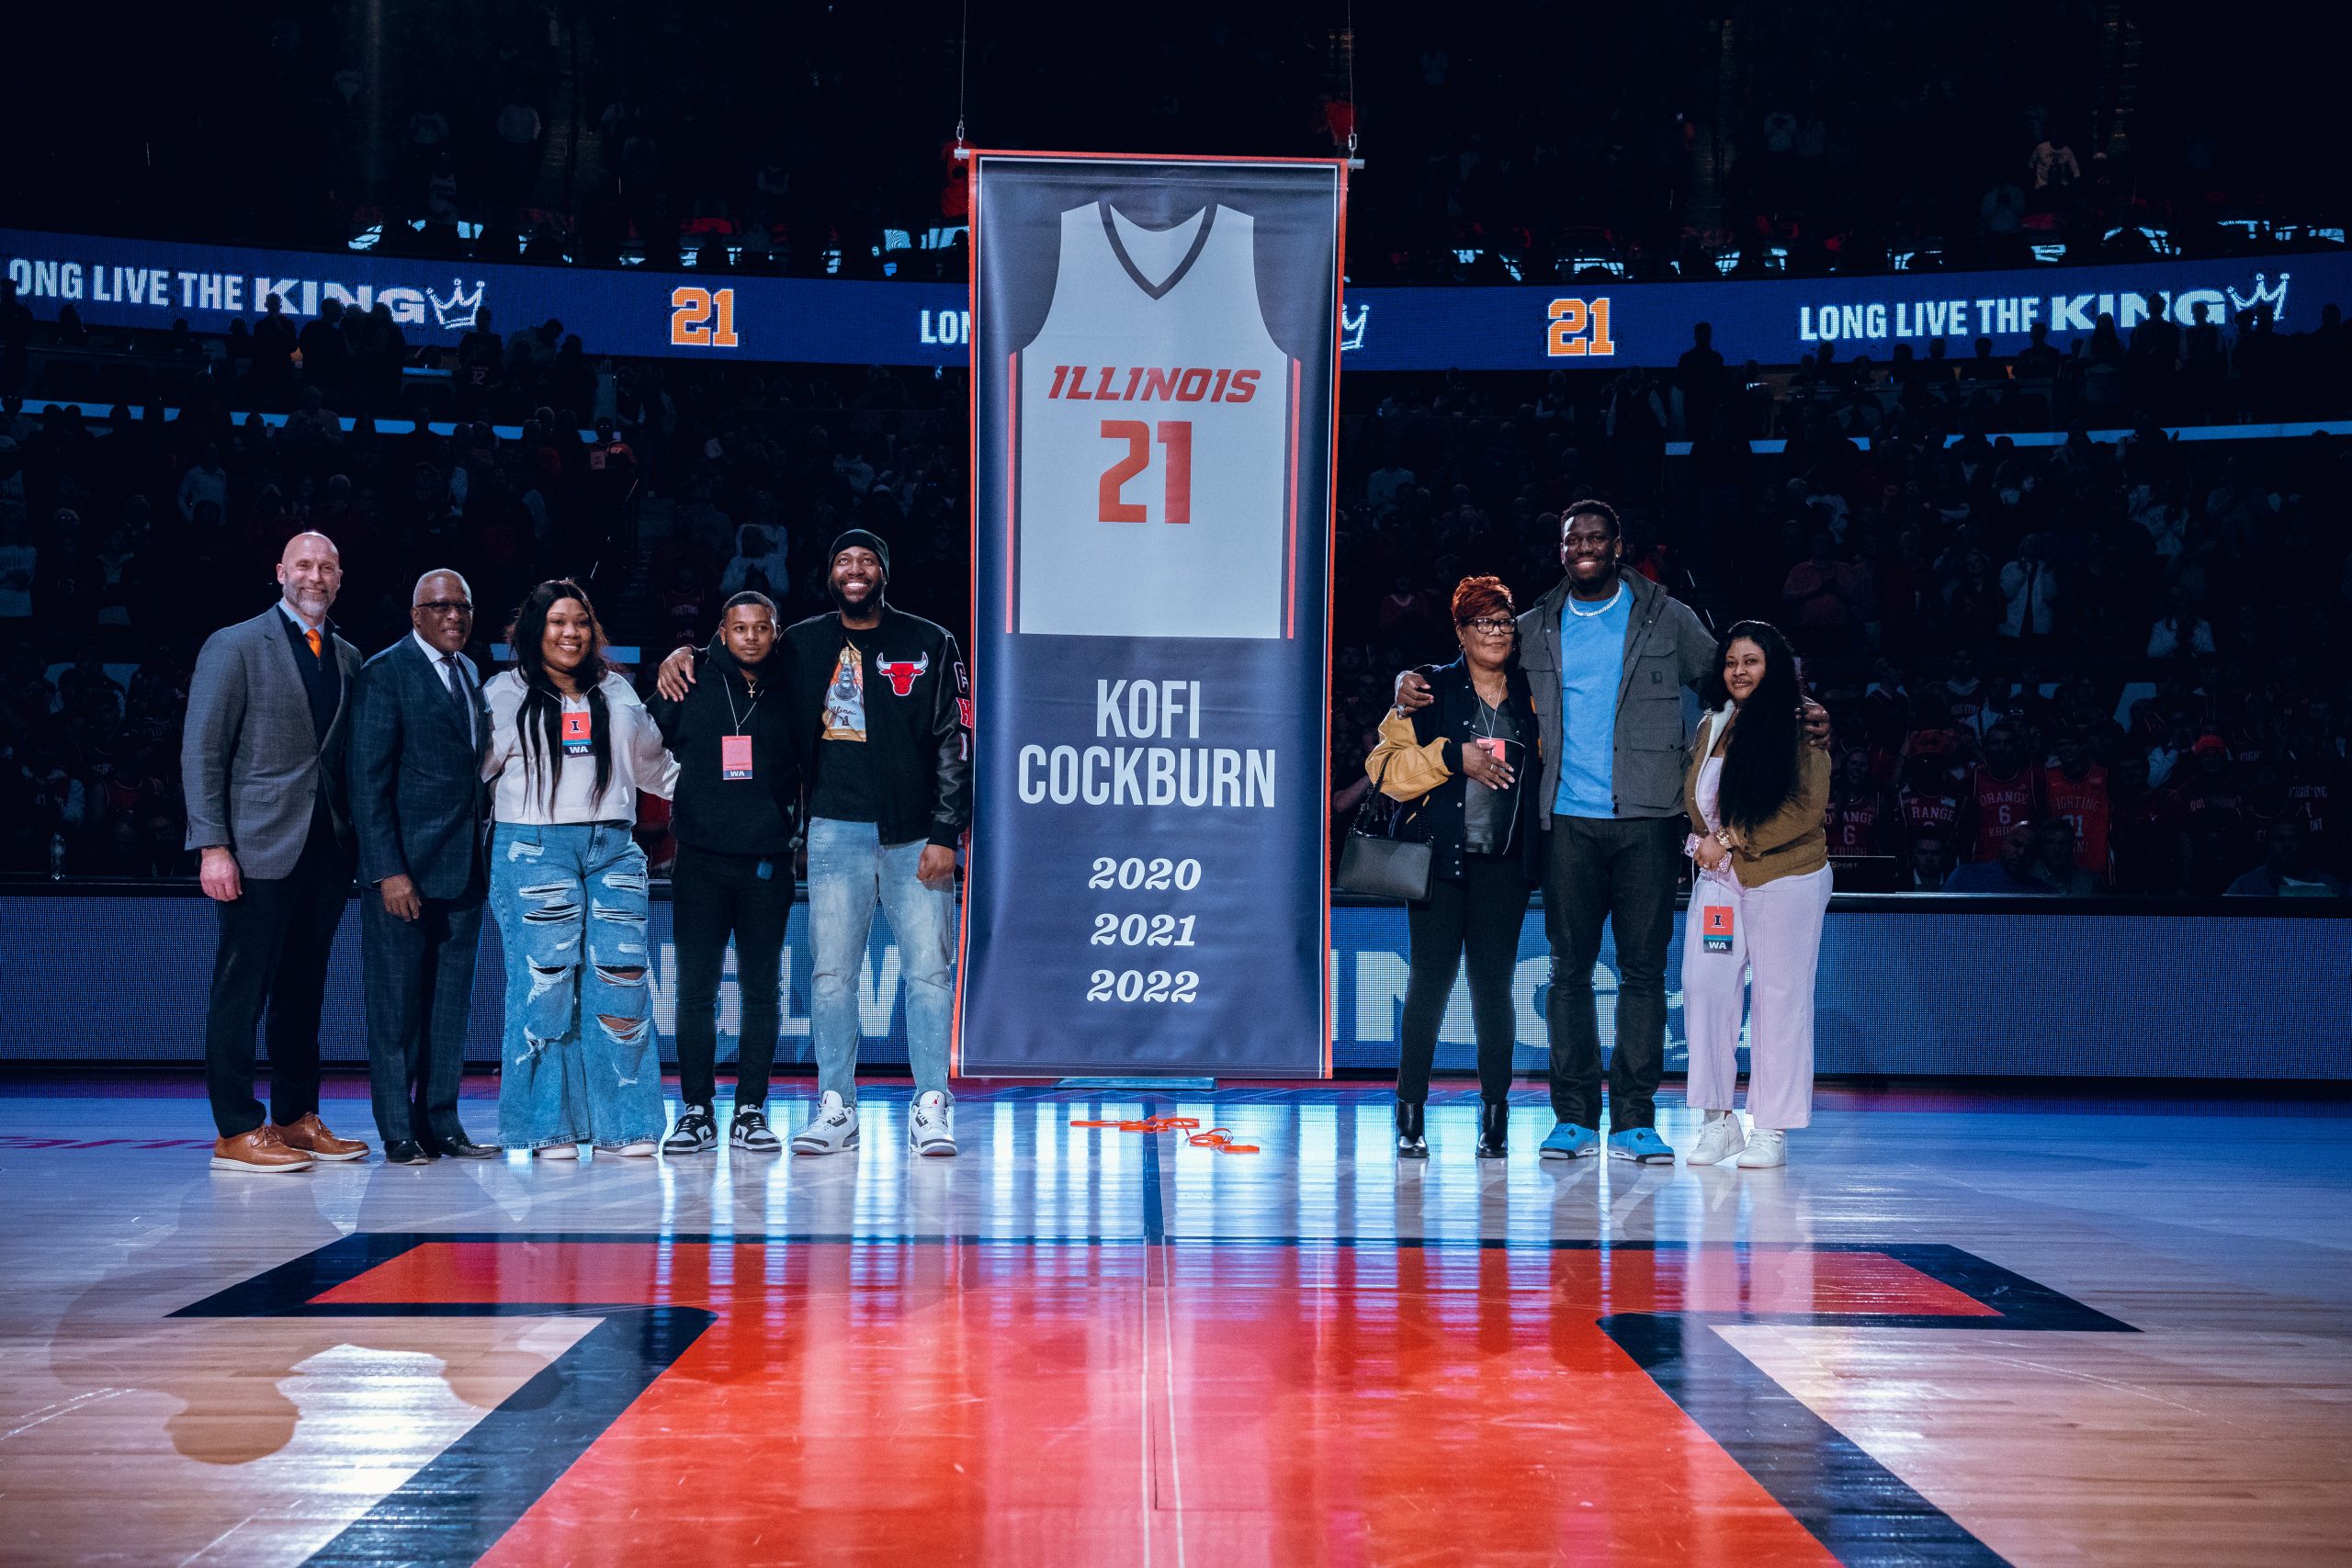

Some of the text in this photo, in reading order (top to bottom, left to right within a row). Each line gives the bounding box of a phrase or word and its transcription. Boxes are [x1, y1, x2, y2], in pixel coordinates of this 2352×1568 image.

[8, 257, 425, 324] ONG LIVE THE KING
[671, 286, 739, 347] 21
[1547, 297, 1615, 356] 21
[1800, 288, 2225, 341] LONG LIVE THE KING
[1047, 364, 1261, 403] ILLINOIS
[1097, 419, 1193, 525] 21
[1095, 679, 1202, 739] KOFI
[569, 745, 589, 754] WA
[1017, 744, 1276, 808] COCKBURN
[1911, 806, 1955, 823] RANGE
[1979, 791, 2029, 807] ORANGE
[1998, 805, 2011, 825] 6
[2052, 795, 2100, 813] IGHTING
[1825, 810, 1875, 825] OANGE
[1843, 825, 1856, 845] 6
[1088, 857, 1202, 891] 2020
[1090, 913, 1196, 947] 2021
[1708, 941, 1727, 950] WA
[1086, 969, 1200, 1004] 2022
